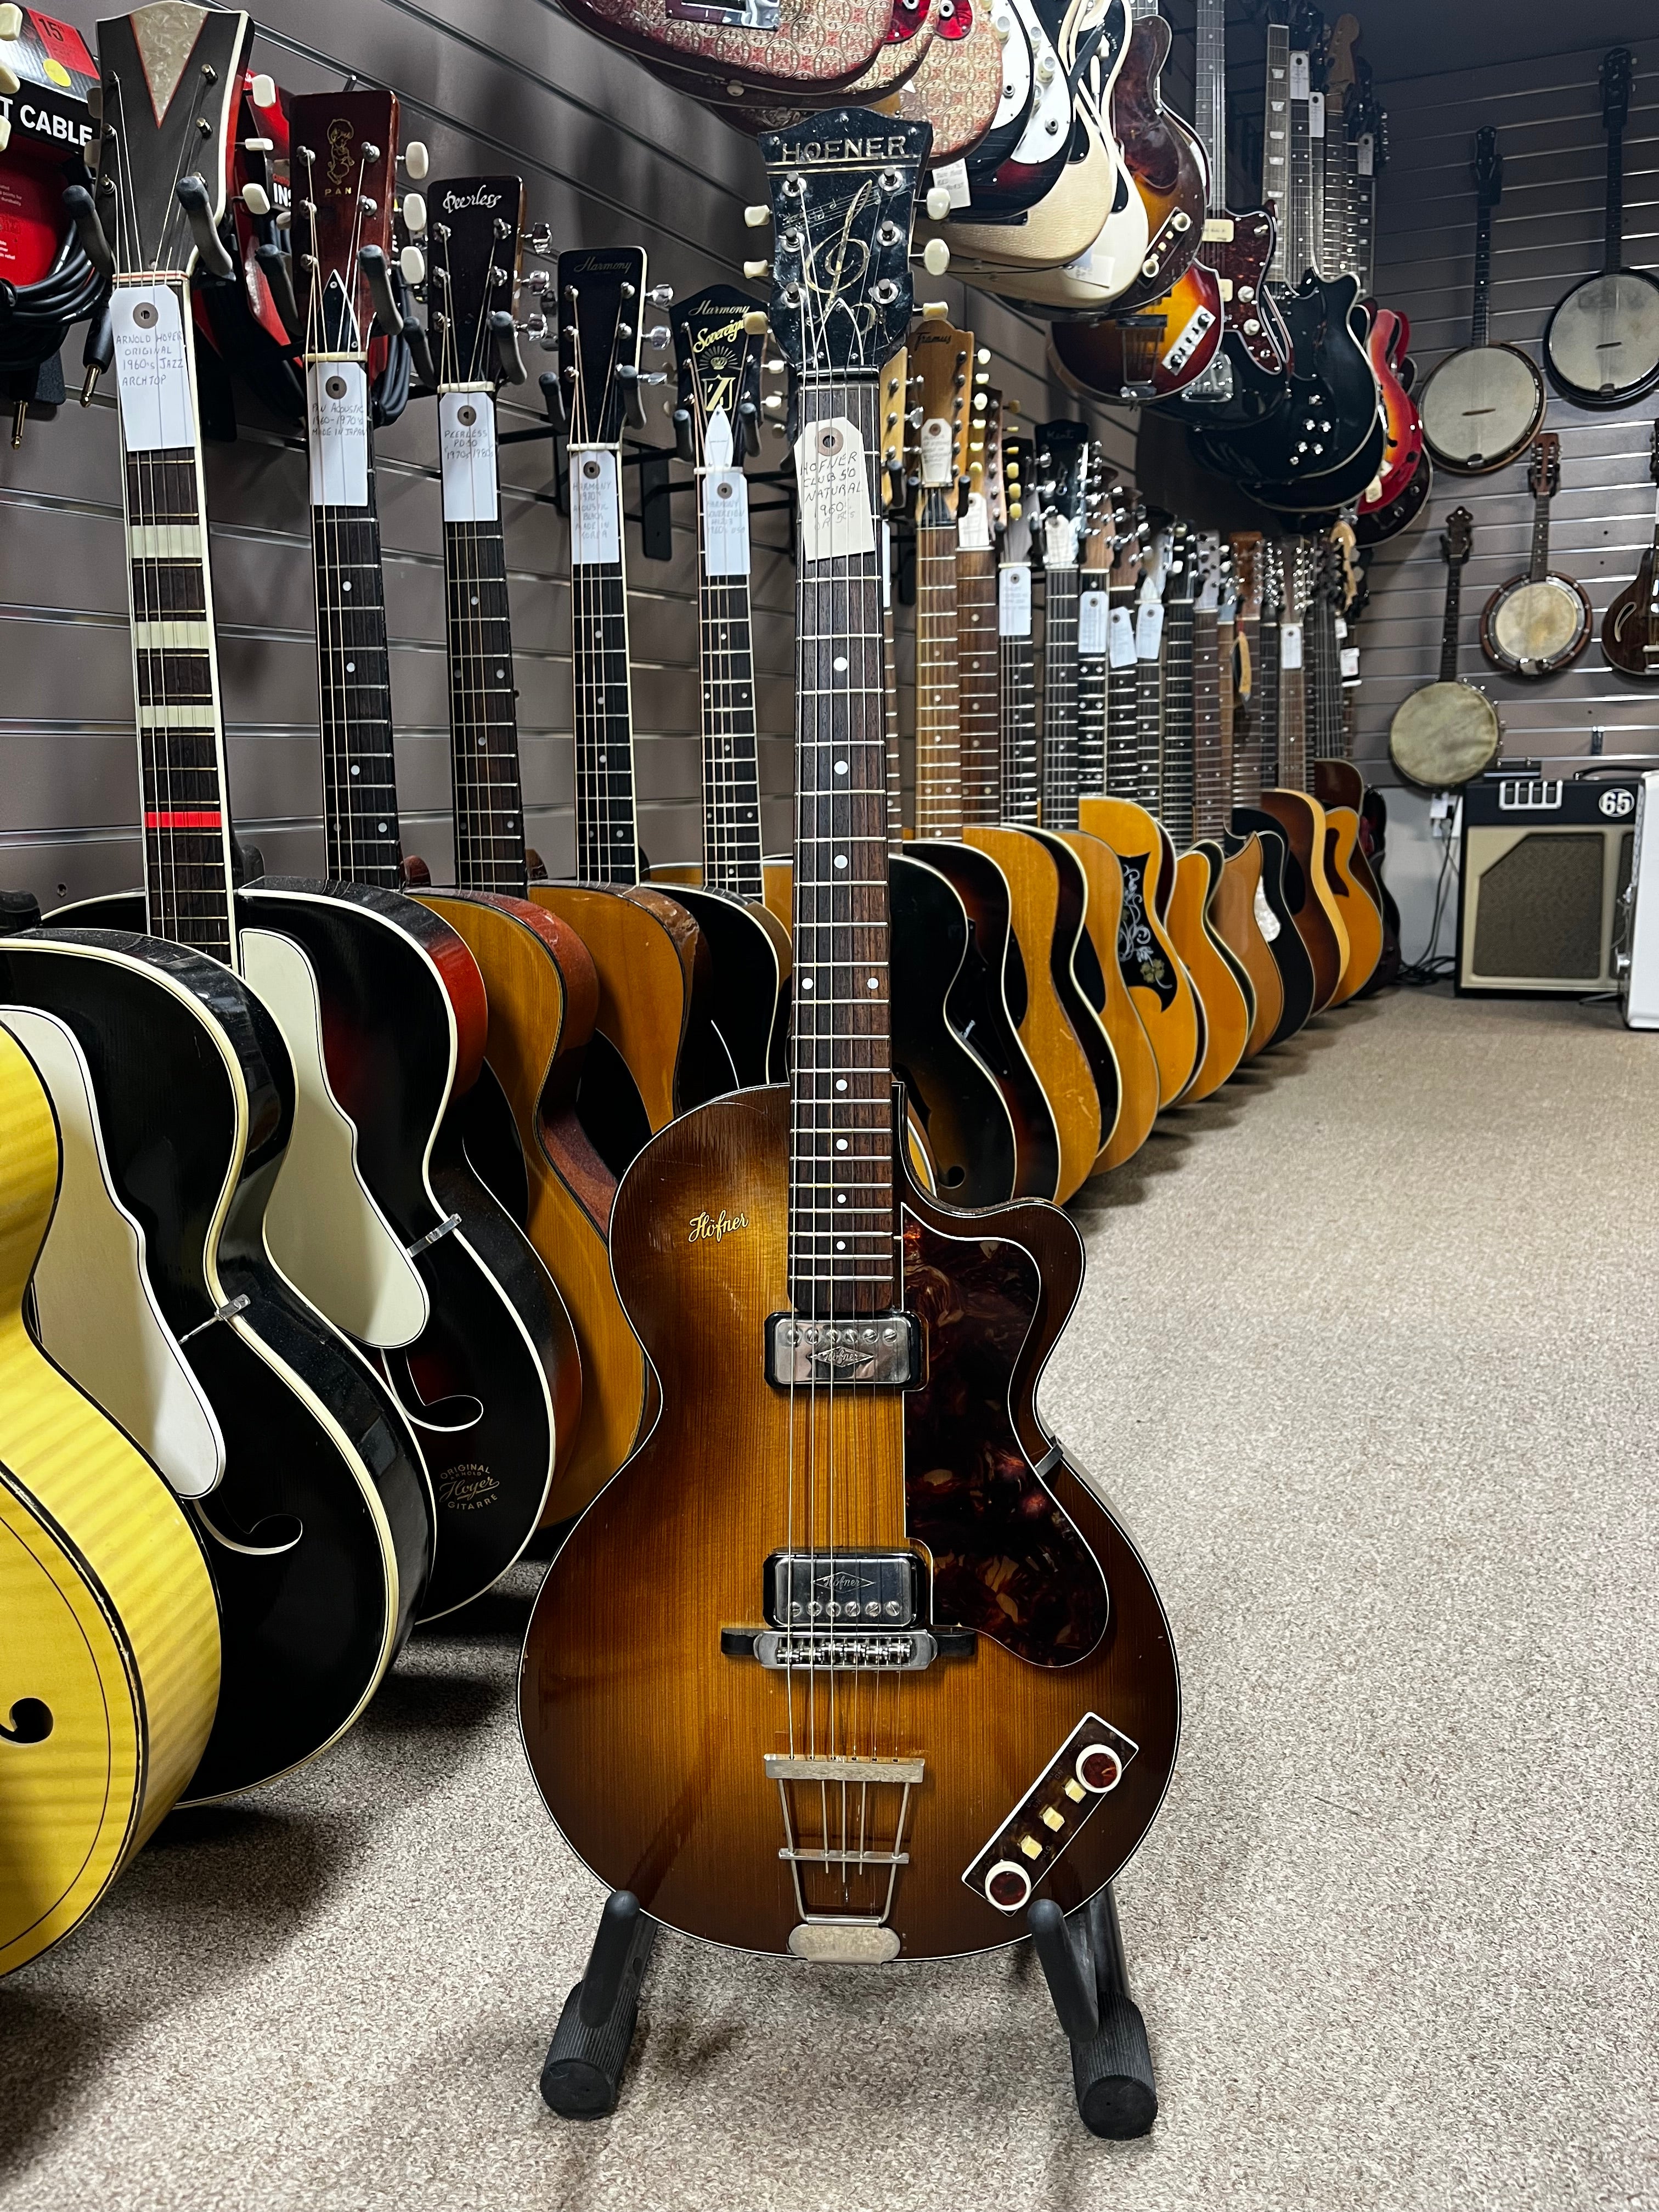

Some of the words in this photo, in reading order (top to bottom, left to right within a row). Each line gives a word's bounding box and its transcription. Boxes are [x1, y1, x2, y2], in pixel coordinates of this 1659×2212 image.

[20, 104, 93, 147] CABLE
[324, 187, 352, 196] PAN
[443, 184, 502, 213] Peerless
[574, 256, 632, 274] Harmony
[688, 300, 750, 316] Harmony
[116, 335, 151, 344] ARNOLD
[156, 331, 182, 342] HOYER
[914, 332, 951, 351] Framus
[125, 346, 172, 356] ORIGINAL
[159, 358, 183, 369] JAZZ
[122, 375, 166, 386] ARCHTOP
[444, 429, 488, 438] PEERLESS
[800, 451, 857, 476] HOFNER
[804, 472, 836, 487] CLUB
[839, 467, 856, 481] 50
[805, 481, 861, 503] NATURAL
[1601, 791, 1632, 815] 65
[688, 1209, 749, 1243] Höfner
[440, 1464, 490, 1479] ORIGINAL
[450, 1471, 482, 1480] ARNOLD
[439, 1476, 500, 1503] Hoyer
[448, 1494, 498, 1510] GITARRE
[823, 1577, 860, 1590] Höfner
